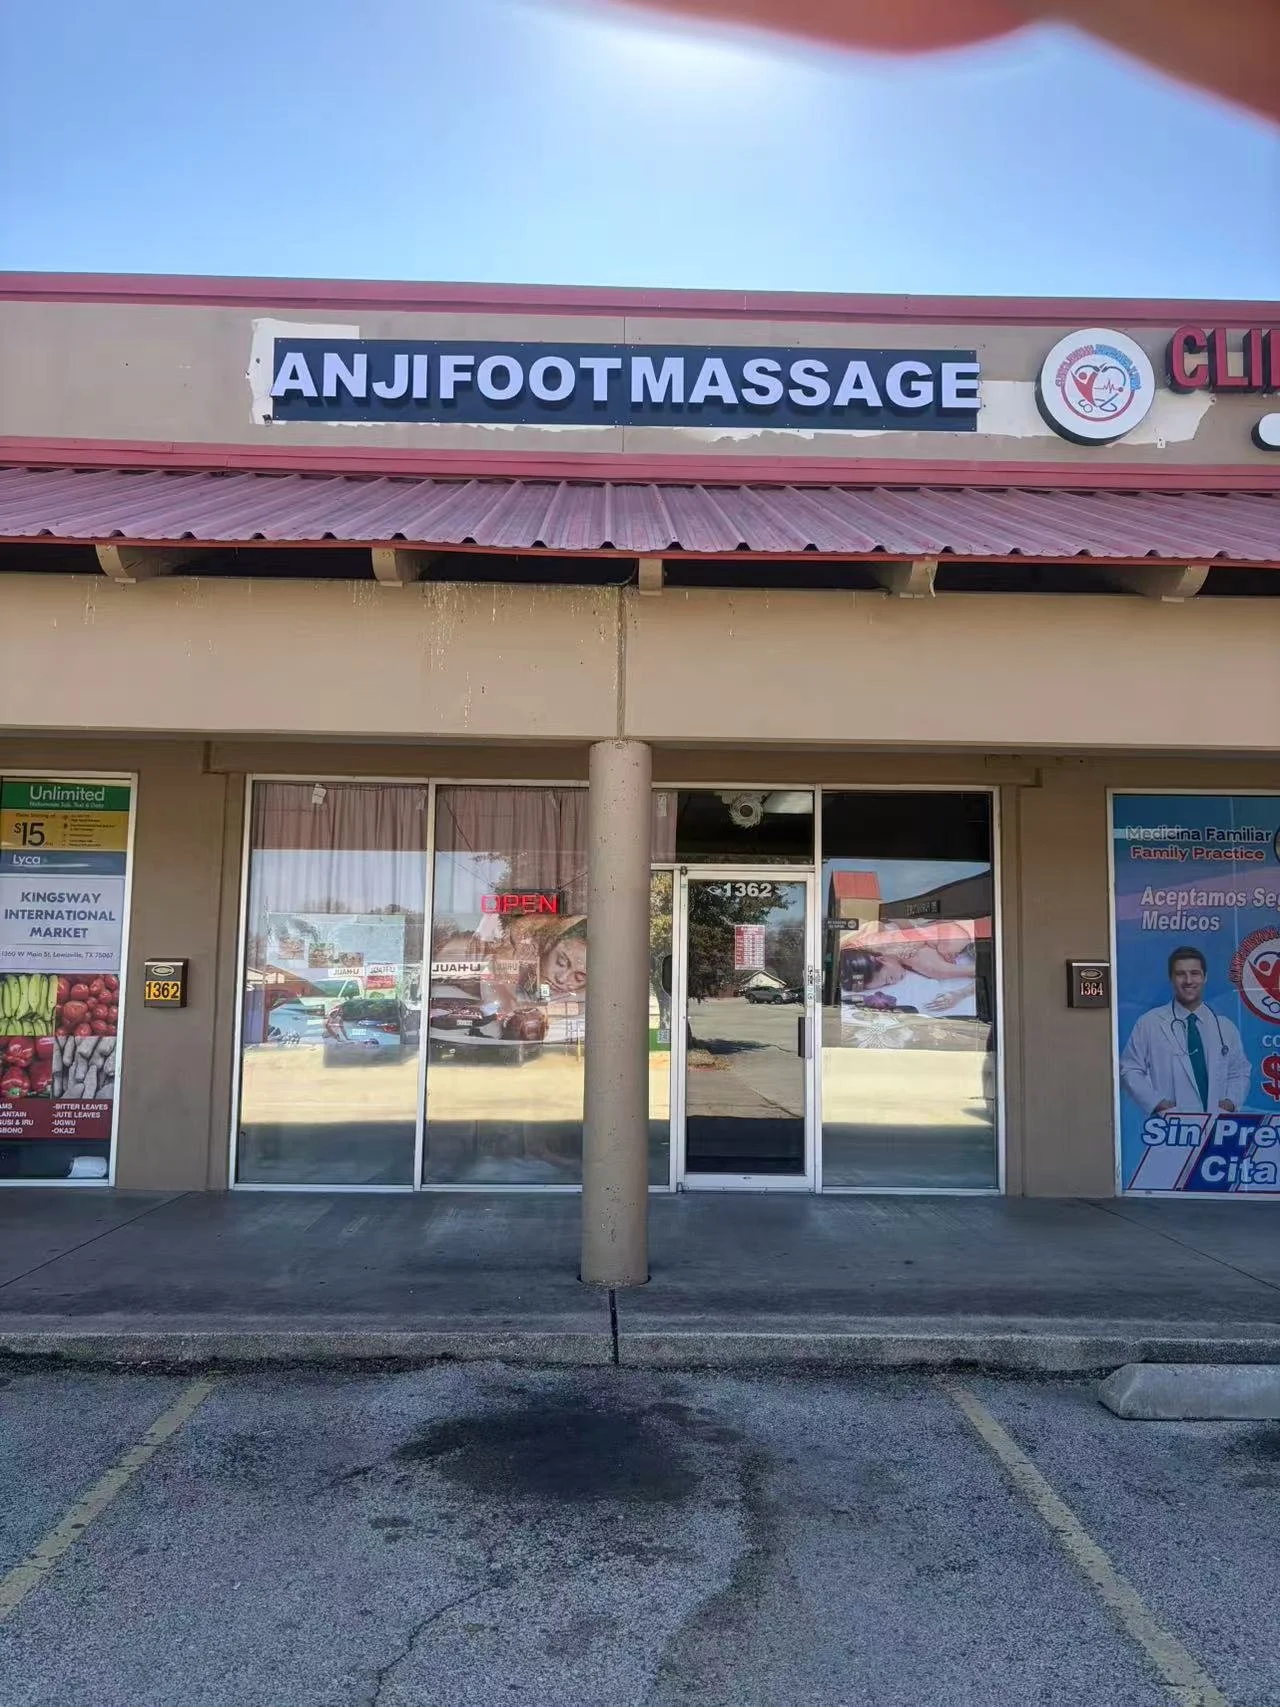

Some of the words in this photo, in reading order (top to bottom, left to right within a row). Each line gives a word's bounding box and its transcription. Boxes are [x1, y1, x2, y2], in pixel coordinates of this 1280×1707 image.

[30, 785, 104, 801] Unlimited
[14, 822, 45, 847] $15
[1127, 826, 1201, 841] Medicina
[1206, 827, 1272, 842] Familiar
[13, 854, 41, 865] Lyca
[1131, 847, 1188, 862] Family
[1193, 848, 1264, 860] Practice
[724, 882, 772, 897] 1362
[20, 892, 101, 904] KINGSWAY
[481, 895, 558, 914] OPEN
[1141, 887, 1246, 909] Aceptamos
[1253, 887, 1280, 912] Se
[4, 909, 116, 921] INTERNATIONAL
[1142, 911, 1219, 931] Medicos
[29, 927, 89, 938] MARKET
[147, 982, 180, 999] 1362
[1080, 982, 1103, 996] 1364
[1142, 1118, 1202, 1145] Sin
[1213, 1119, 1280, 1146] Pre
[1201, 1155, 1277, 1184] Cita
